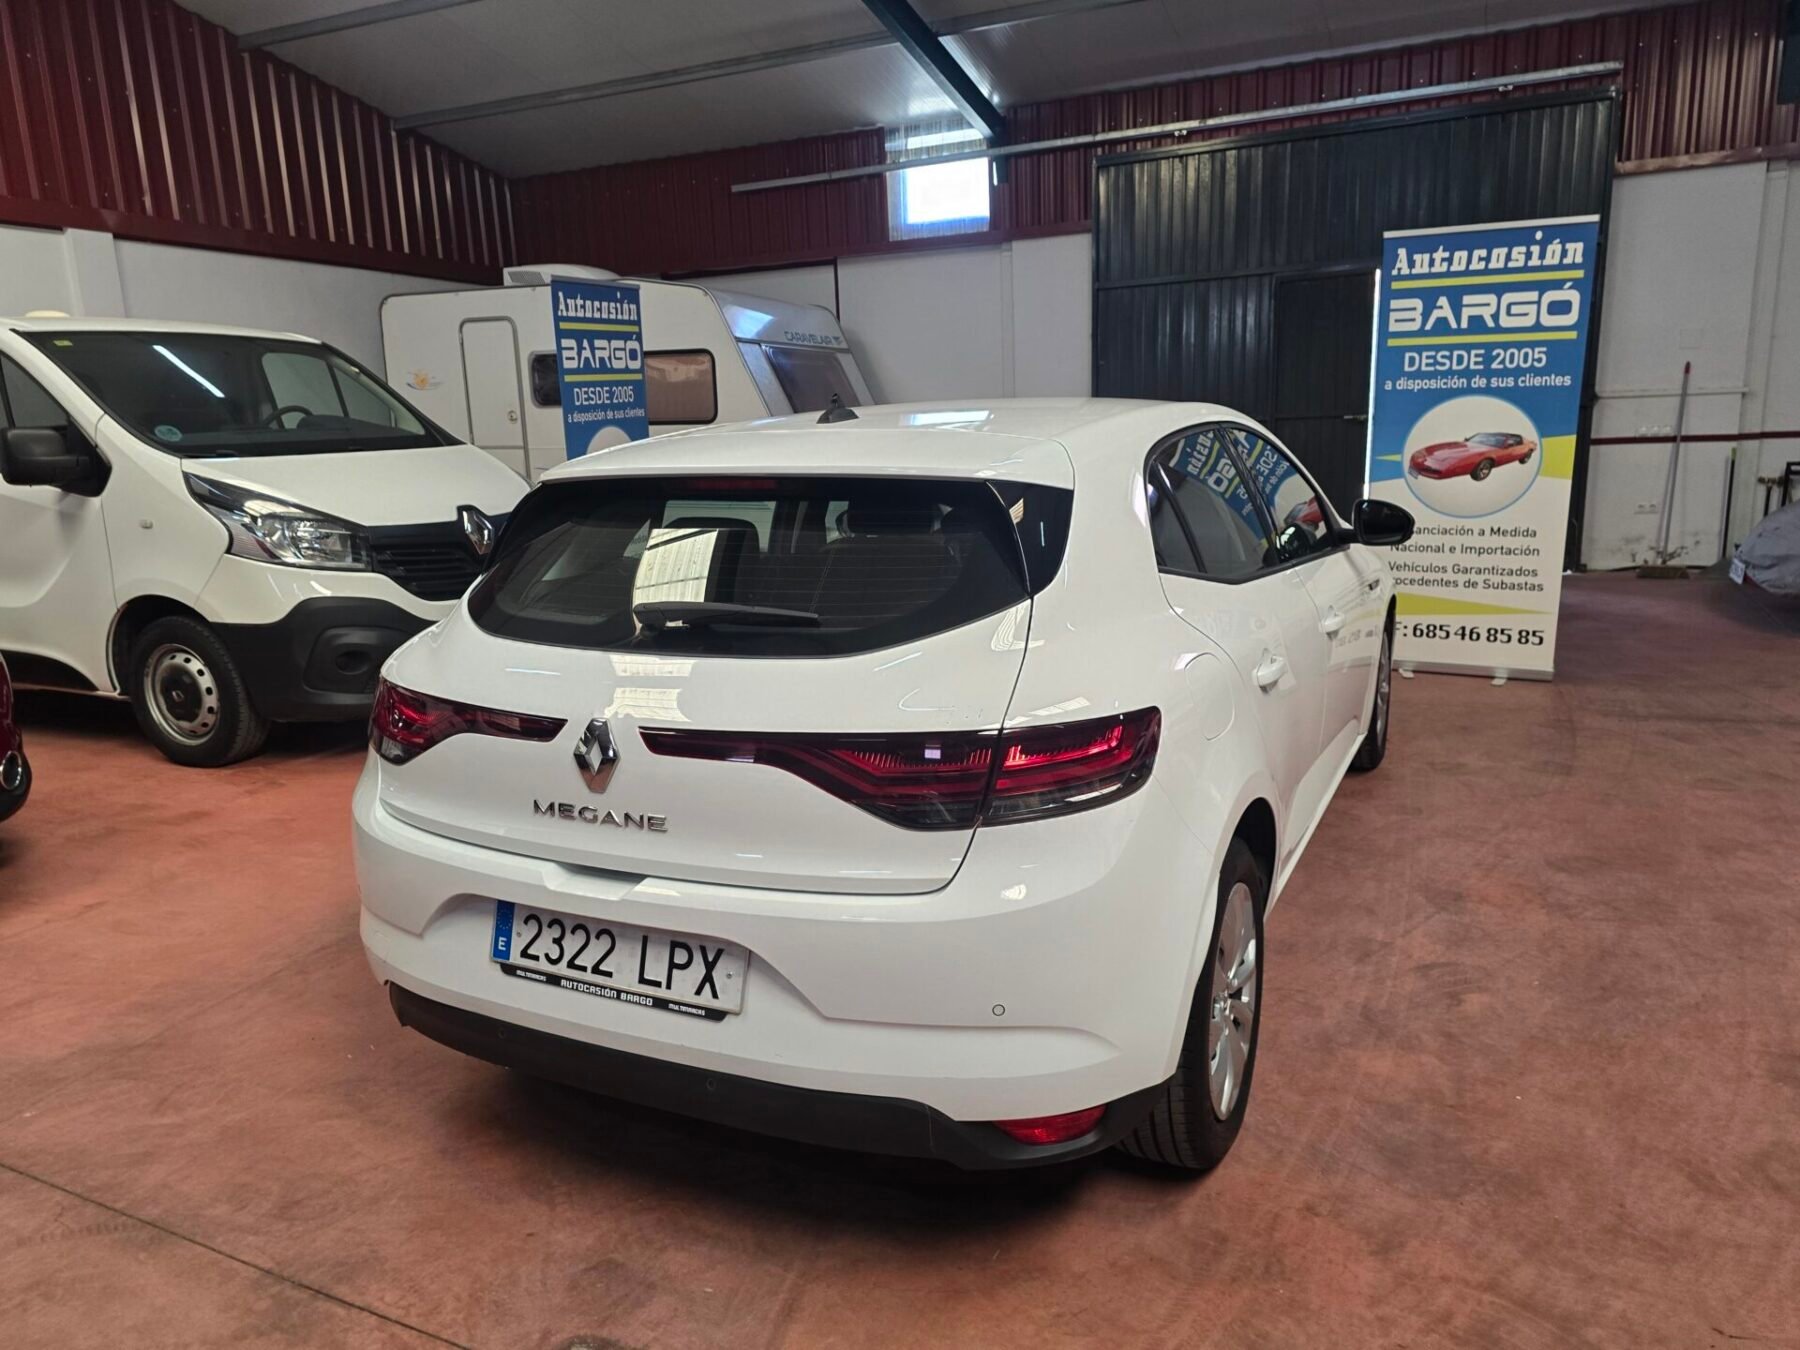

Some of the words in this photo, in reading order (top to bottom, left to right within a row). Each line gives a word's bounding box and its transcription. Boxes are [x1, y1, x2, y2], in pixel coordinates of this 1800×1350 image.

[1392, 230, 1585, 275] Autocasión
[557, 291, 637, 321] Autocasión
[1388, 281, 1581, 332] BARGÓ
[561, 335, 642, 370] BARGÓ
[1403, 350, 1485, 372] DESDE
[1491, 347, 1548, 369] 2005
[1384, 381, 1393, 391] a
[1396, 376, 1467, 393] disposición
[1471, 375, 1487, 388] de
[1490, 377, 1514, 388] sus
[1518, 373, 1572, 387] clientes
[573, 387, 610, 406] DESDE
[612, 386, 634, 403] 2005
[573, 408, 605, 424] disposición
[607, 408, 613, 420] de
[614, 409, 624, 418] sus
[625, 407, 645, 418] clientes
[1412, 525, 1474, 537] anciación
[1478, 529, 1485, 537] a
[1490, 526, 1537, 538] Medida
[1390, 542, 1445, 554] Nacional
[1460, 543, 1540, 557] Importación
[1388, 561, 1448, 574] Vehículos
[1452, 563, 1538, 577] Garantizados
[1393, 576, 1459, 588] ocedentes
[1463, 578, 1479, 589] de
[1482, 578, 1544, 592] Subastas
[1486, 627, 1513, 644] 85
[1517, 629, 1545, 646] 85
[533, 799, 668, 833] MEGANE
[498, 937, 506, 951] E
[519, 913, 617, 979] 2322
[637, 934, 725, 1000] LPX
